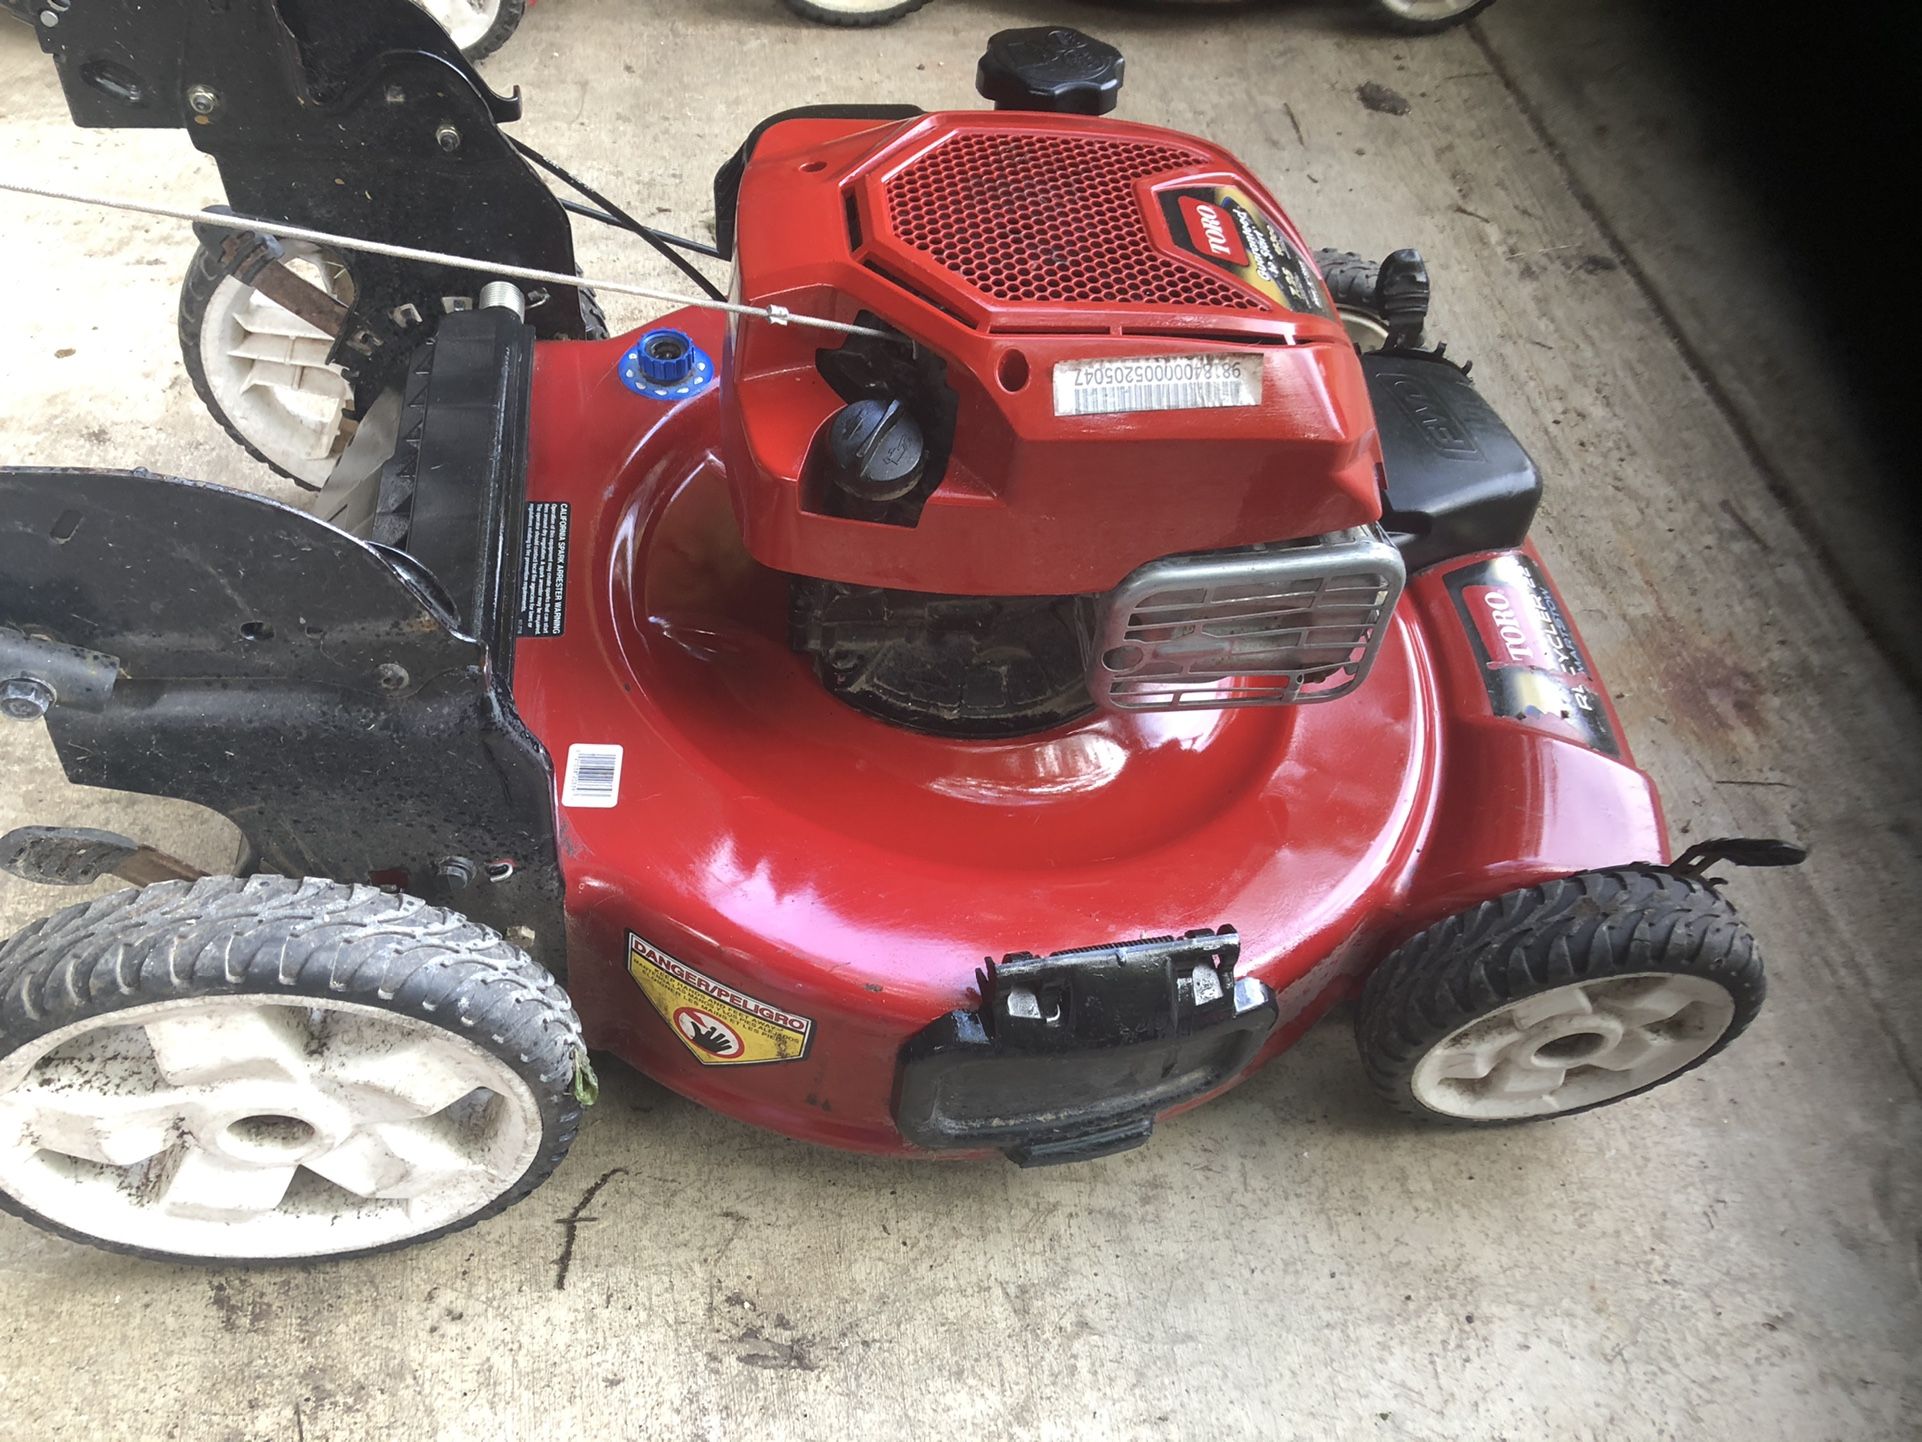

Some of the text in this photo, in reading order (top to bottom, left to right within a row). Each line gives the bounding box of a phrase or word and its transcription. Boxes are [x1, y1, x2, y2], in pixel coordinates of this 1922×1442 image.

[1196, 205, 1230, 255] TORO
[1232, 207, 1270, 281] Guaranteed
[553, 503, 567, 633] CALIFORNIA SPARK ARRESTER WARNING
[1485, 591, 1534, 662] TORO
[1540, 587, 1585, 672] MARTSTOW
[634, 939, 804, 1030] DANGER/PELIGRO
[672, 983, 686, 994] LAS
[688, 992, 714, 1009] MANOS
[722, 1010, 737, 1019] LOS
[740, 1017, 757, 1028] PIES
[759, 1025, 800, 1044] ALEJADOS
[677, 982, 706, 1000] HANDS
[708, 998, 725, 1009] AND
[728, 1006, 748, 1019] FEET
[683, 995, 699, 1006] LES
[701, 1004, 727, 1020] MAINS
[730, 1018, 740, 1026] ET
[742, 1024, 759, 1034] LES
